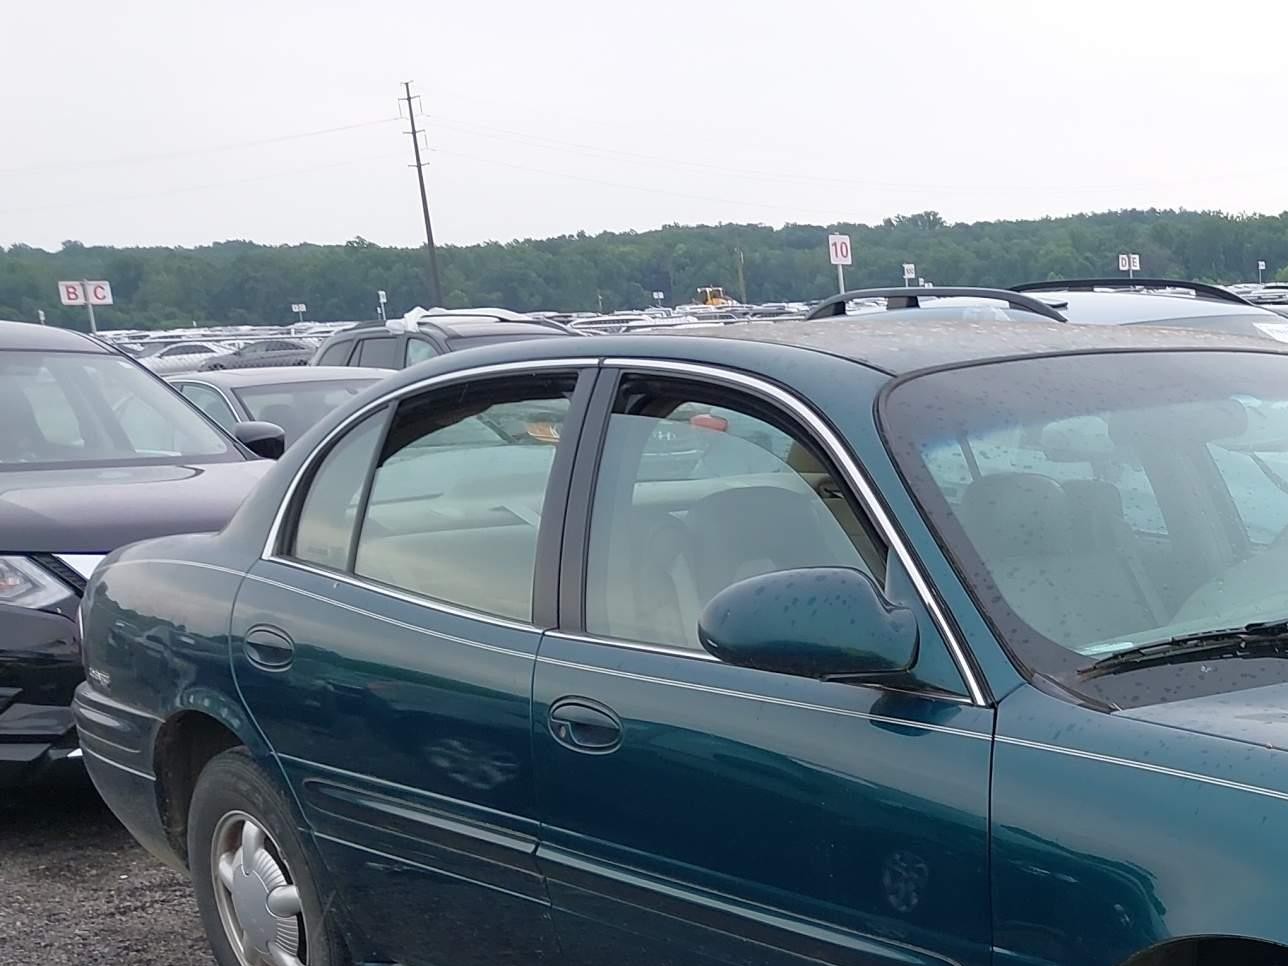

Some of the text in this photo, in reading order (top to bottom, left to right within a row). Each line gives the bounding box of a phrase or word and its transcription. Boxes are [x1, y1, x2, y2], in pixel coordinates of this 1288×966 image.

[832, 241, 849, 258] 10
[1121, 256, 1127, 268] D
[1132, 256, 1138, 268] E
[65, 285, 79, 301] B
[94, 285, 106, 301] C
